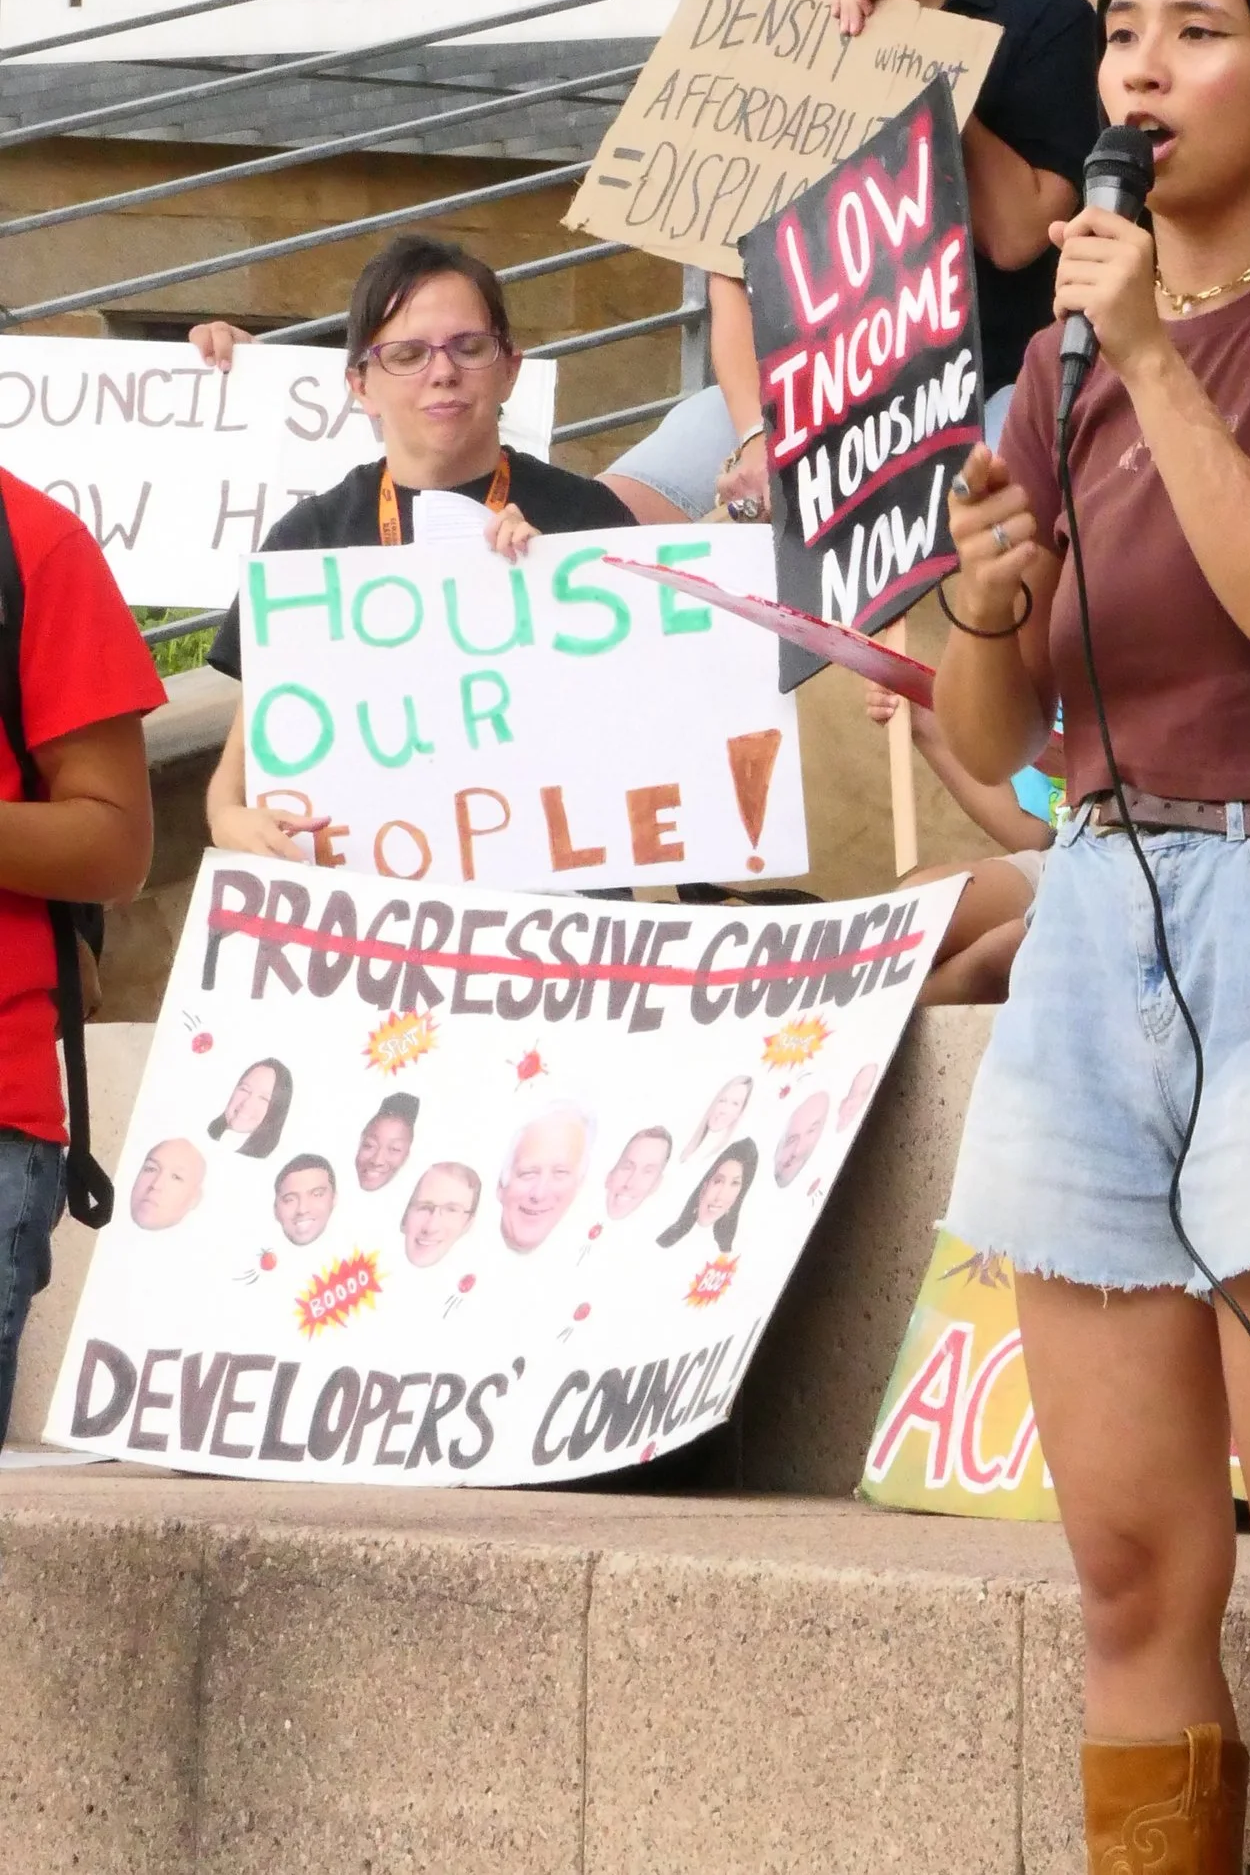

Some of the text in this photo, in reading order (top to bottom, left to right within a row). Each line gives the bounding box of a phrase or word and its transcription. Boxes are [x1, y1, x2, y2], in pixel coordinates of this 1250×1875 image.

[785, 134, 930, 326] LOW
[769, 238, 962, 460] INCOME
[796, 348, 979, 545] HOUSING
[820, 463, 947, 627] NOW
[200, 868, 922, 1033] PROGRESSIVE COUNCIL
